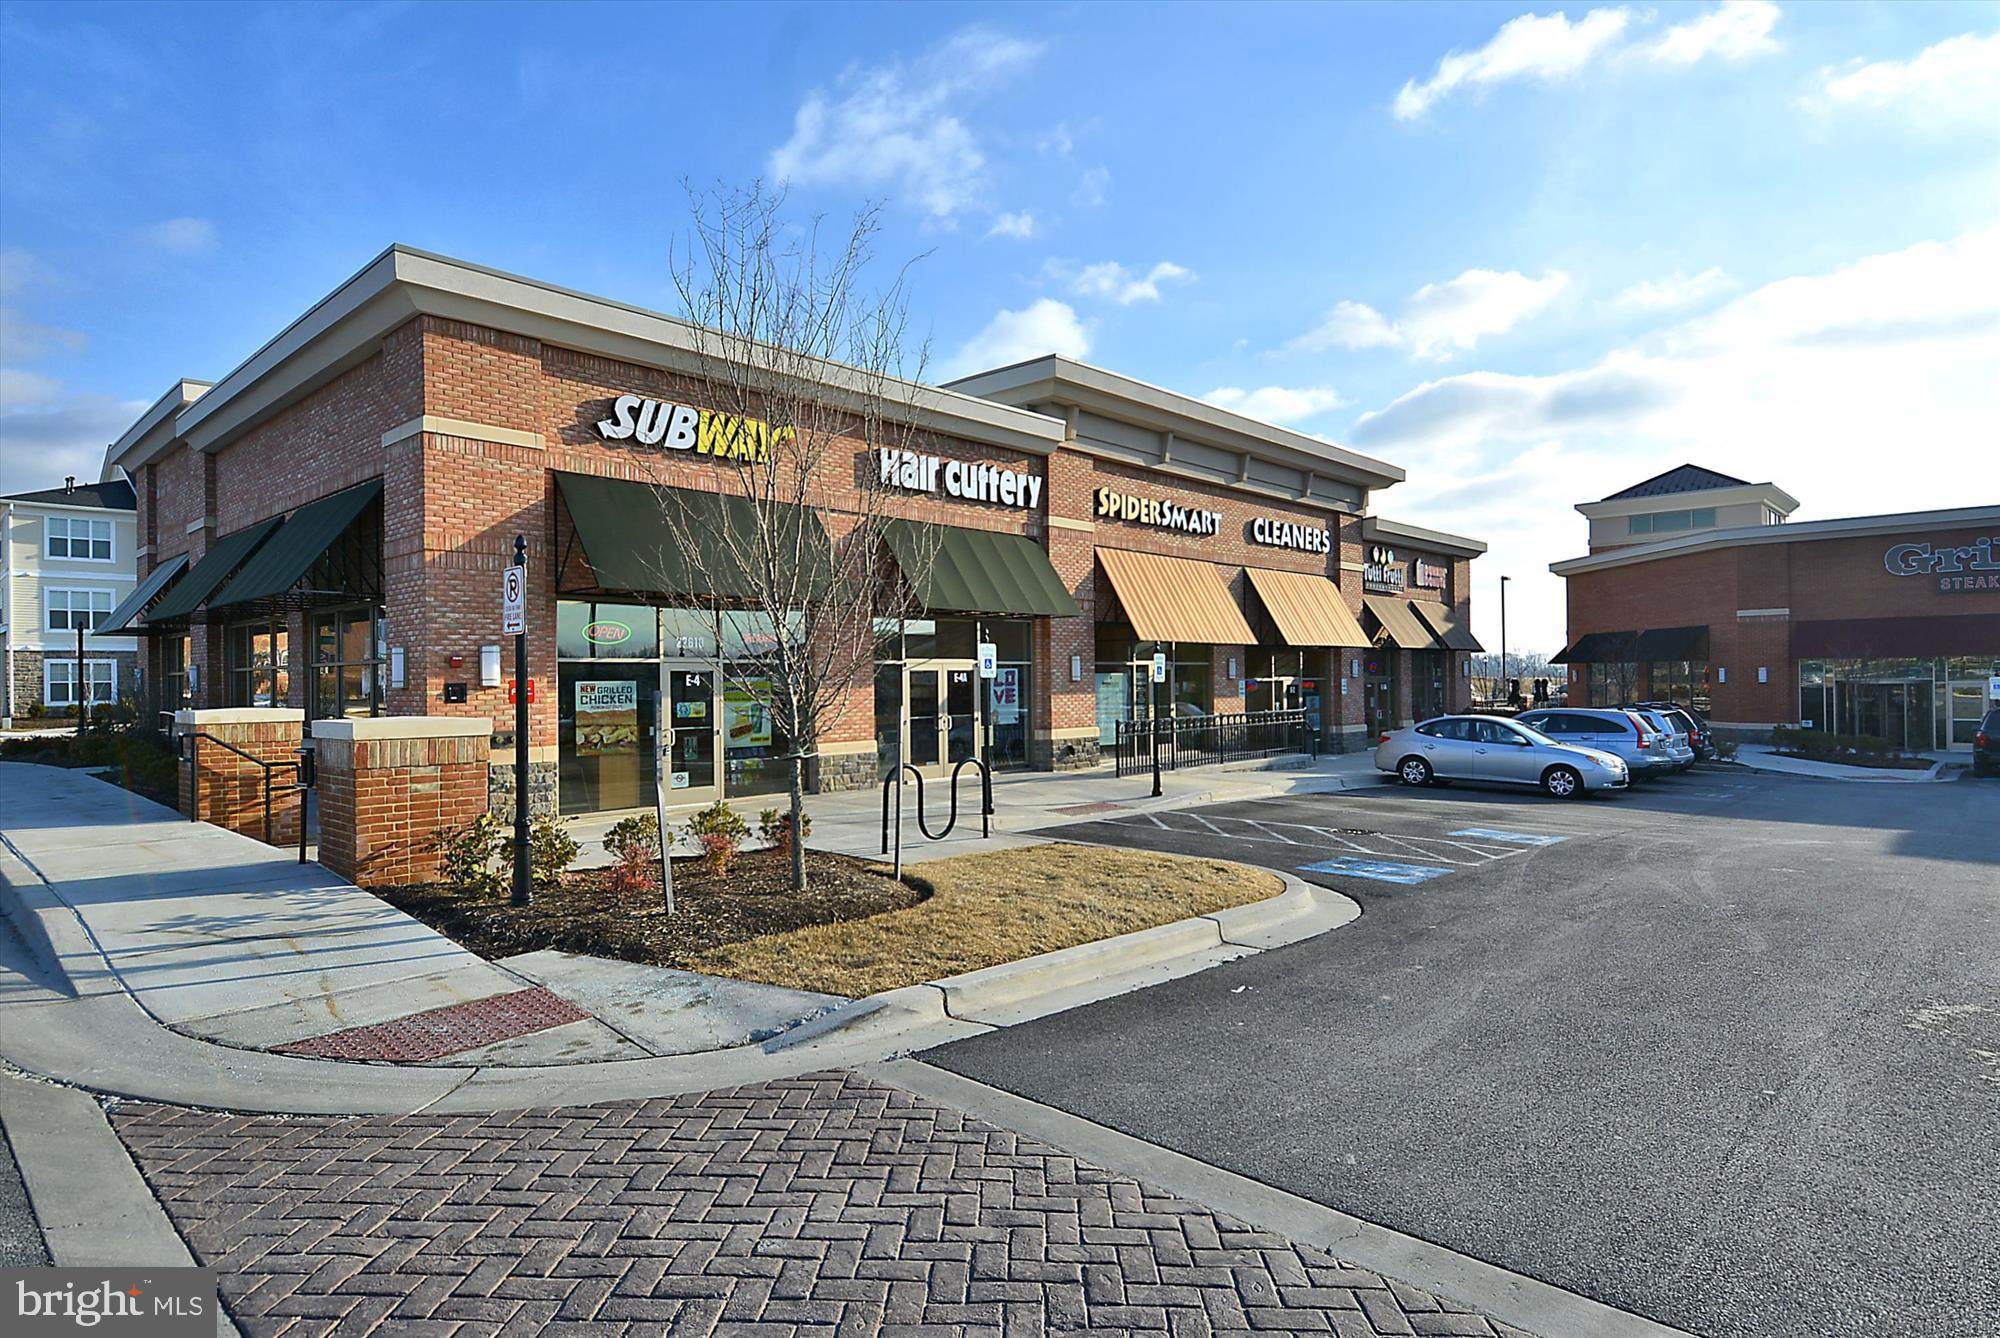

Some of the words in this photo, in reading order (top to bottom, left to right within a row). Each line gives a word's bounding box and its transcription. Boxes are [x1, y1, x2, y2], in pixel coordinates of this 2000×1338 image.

[597, 394, 795, 463] SUBWAY
[879, 447, 941, 494] Hair
[944, 459, 1043, 509] cuttery
[1252, 517, 1332, 555] CLEANERS
[1940, 575, 2000, 590] STEAK
[588, 624, 625, 641] OPEN
[685, 674, 701, 687] E-4
[580, 685, 596, 693] NEW
[597, 686, 633, 694] GRILLED
[580, 694, 633, 705] CHICKEN
